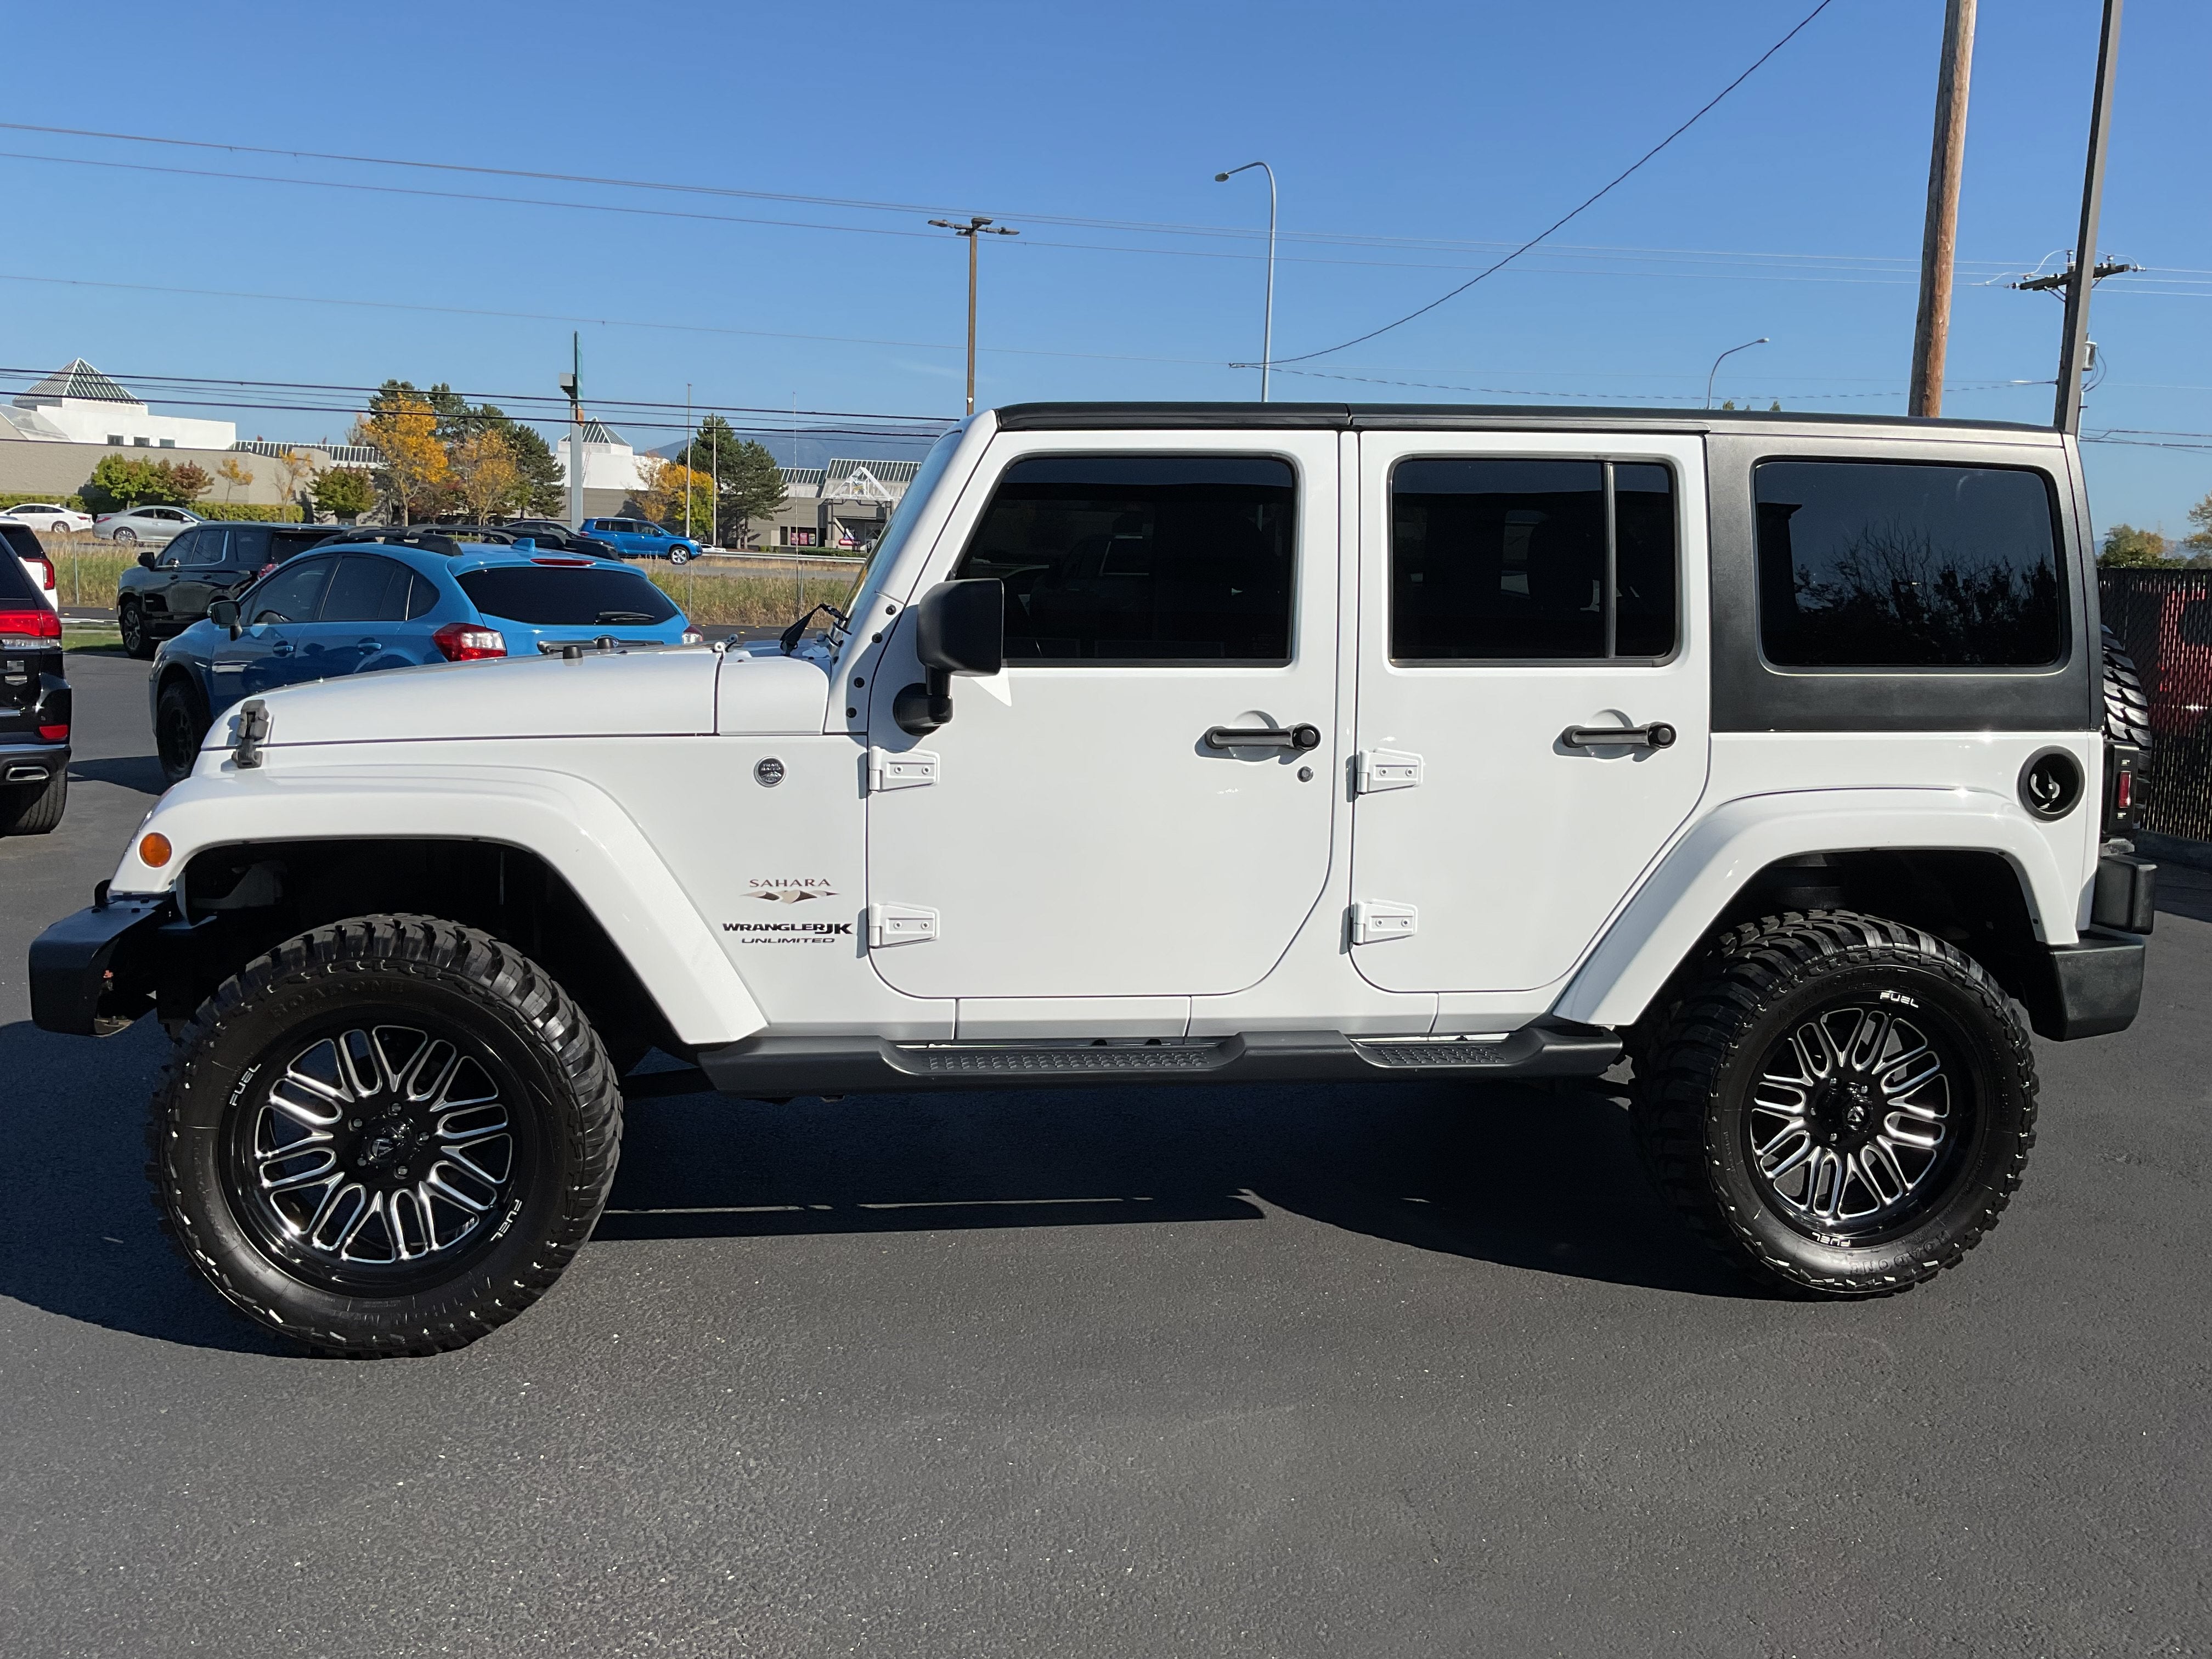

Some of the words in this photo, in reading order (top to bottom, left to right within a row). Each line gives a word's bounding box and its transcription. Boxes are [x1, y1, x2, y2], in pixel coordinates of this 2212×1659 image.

[749, 879, 831, 888] SAHARA
[1880, 991, 1919, 1008] FUEL
[229, 1064, 262, 1107] FUEL
[490, 1199, 522, 1242] FUEL
[1812, 1232, 1851, 1248] FUEL
